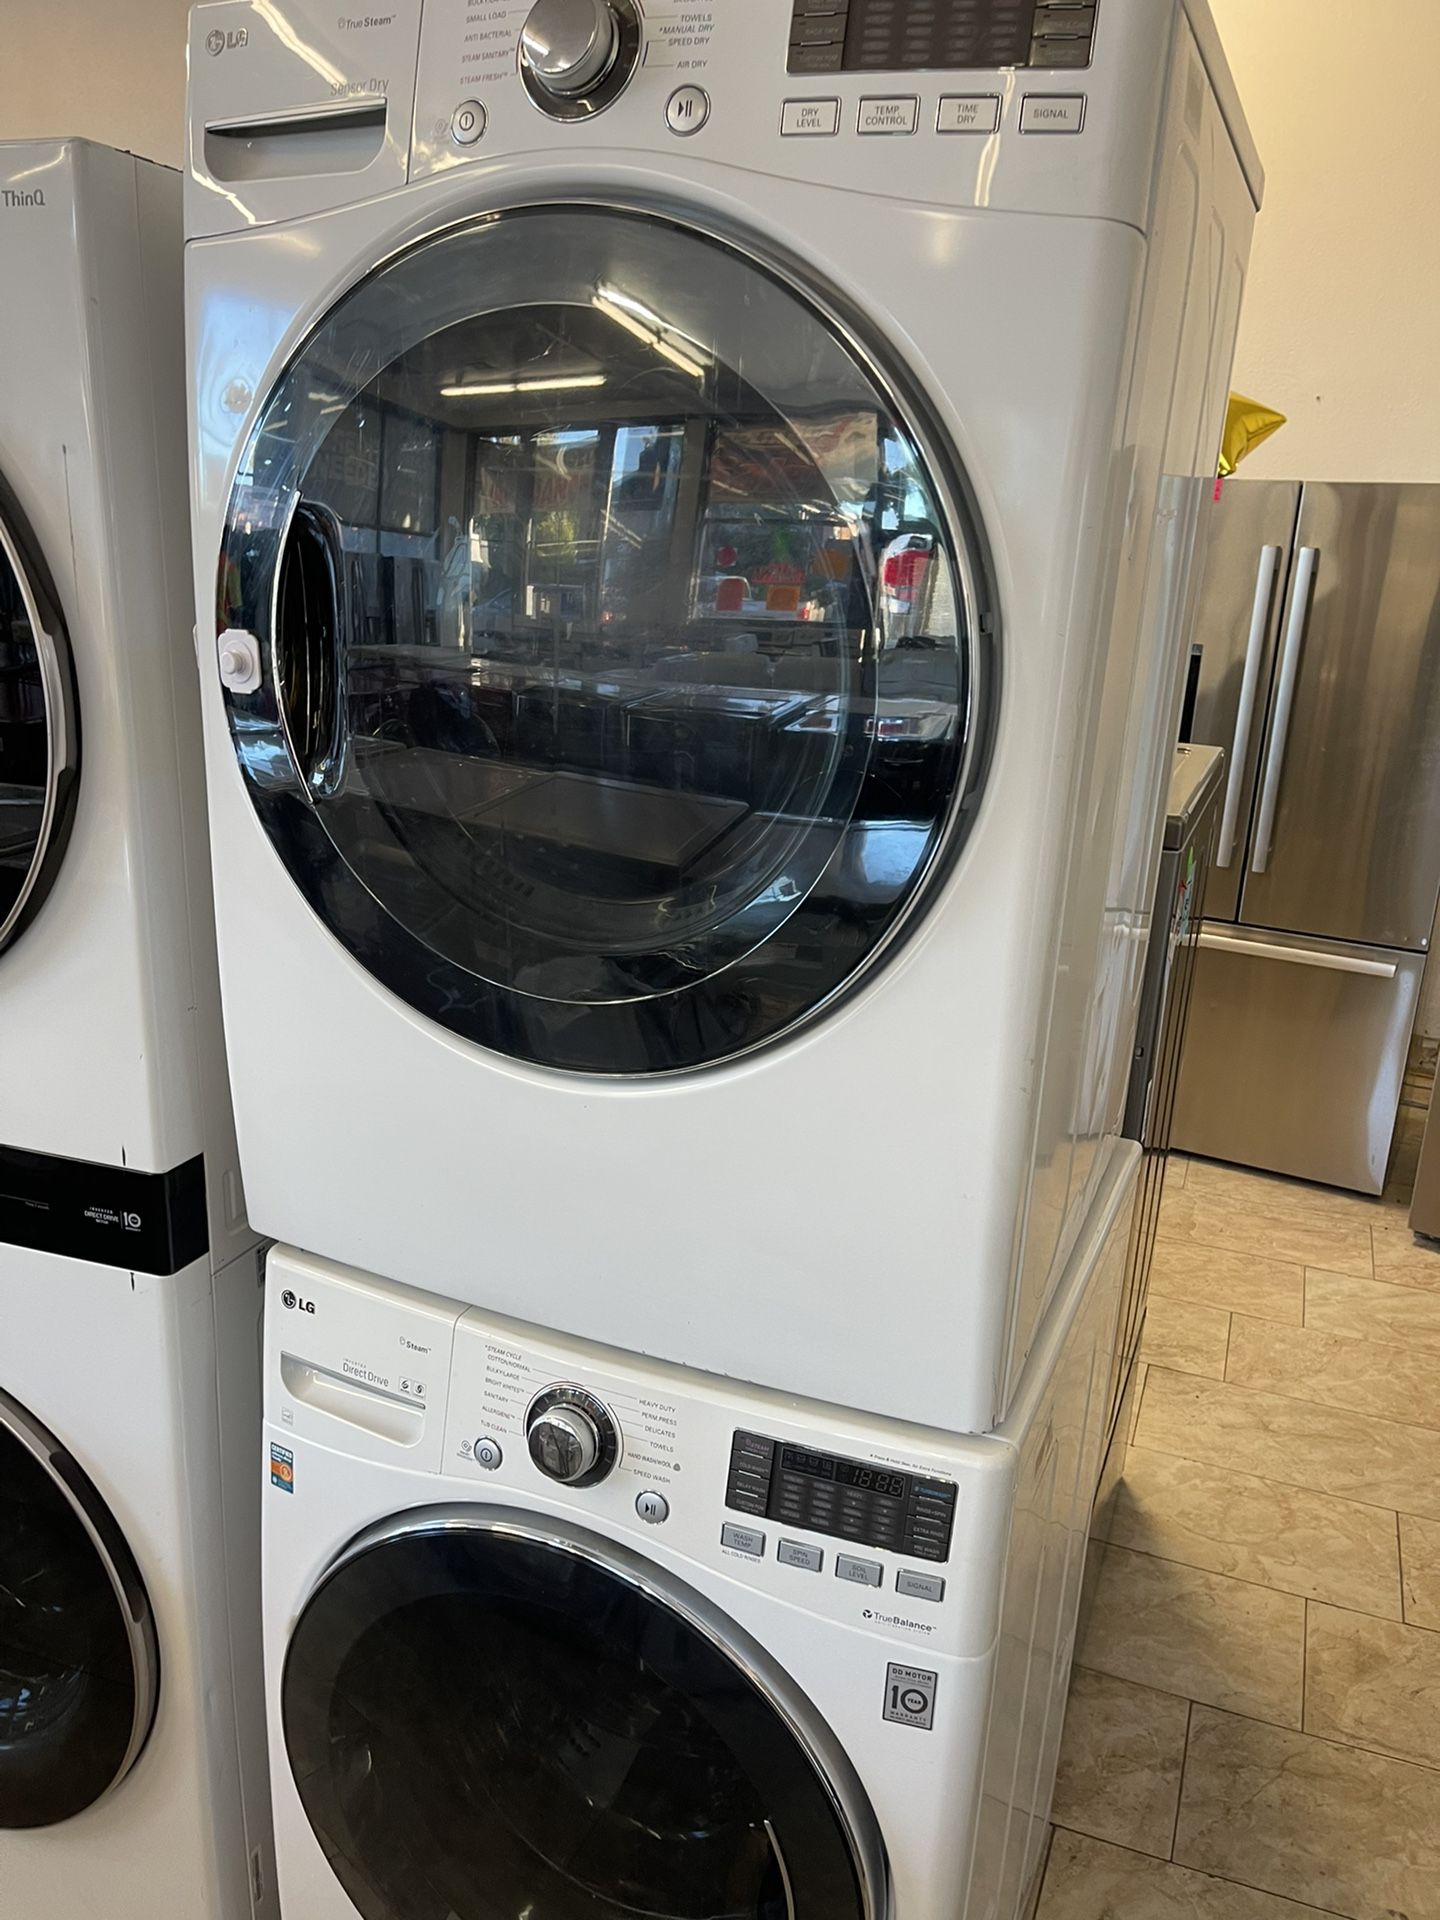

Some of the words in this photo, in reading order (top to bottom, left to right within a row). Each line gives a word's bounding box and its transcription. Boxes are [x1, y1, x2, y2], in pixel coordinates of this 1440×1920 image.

[465, 13, 486, 24] SMALL
[488, 10, 507, 20] LOAD
[681, 13, 713, 22] TOWELS
[698, 23, 715, 33] DRY
[226, 27, 249, 49] LG
[464, 33, 479, 42] ANTI
[480, 29, 512, 41] BACTERIAL
[668, 37, 693, 47] SPEED
[693, 36, 710, 46] DRY
[676, 60, 690, 70] AIR
[691, 59, 707, 69] DRY
[331, 80, 368, 97] Sensor
[369, 78, 390, 95] Dry
[801, 107, 820, 118] DRY
[957, 103, 979, 114] TIME
[1033, 108, 1069, 120] SIGNAL
[796, 118, 823, 129] LEVEL
[865, 115, 908, 127] CONTROL
[957, 114, 976, 125] DRY
[1, 188, 46, 207] ThinQ
[84, 1210, 103, 1219] DIRECT
[103, 1213, 119, 1223] DRIVE
[123, 1211, 142, 1228] 10
[298, 1297, 316, 1315] LG
[505, 1351, 522, 1361] CYCLE
[487, 1353, 531, 1373] COTTON/NORMAL
[343, 1362, 367, 1379] Direct
[367, 1371, 389, 1387] Drive
[486, 1365, 520, 1381] BULKY/LARGE
[485, 1377, 502, 1388] BRIGHT
[483, 1390, 509, 1403] SANITARY
[639, 1399, 659, 1409] HEAVY
[659, 1403, 676, 1413] DUTY
[481, 1419, 491, 1429] TUB
[490, 1423, 508, 1434] CLEAN
[644, 1425, 676, 1439] DELICATES
[649, 1441, 674, 1453] TOWELS
[627, 1452, 642, 1461] HAND
[633, 1468, 652, 1479] SPEED
[652, 1474, 671, 1484] WASH
[733, 1532, 753, 1543] WASH
[730, 1551, 744, 1559] COLD
[792, 1548, 808, 1558] SPIN
[788, 1554, 811, 1566] SPEED
[851, 1564, 866, 1574] SOIL
[848, 1570, 869, 1581] LEVEL
[906, 1581, 933, 1593] SIGNAL
[892, 1667, 904, 1676] DD
[905, 1670, 933, 1682] MOTOR
[891, 1684, 929, 1715] 10
[907, 1697, 922, 1705] YEAR
